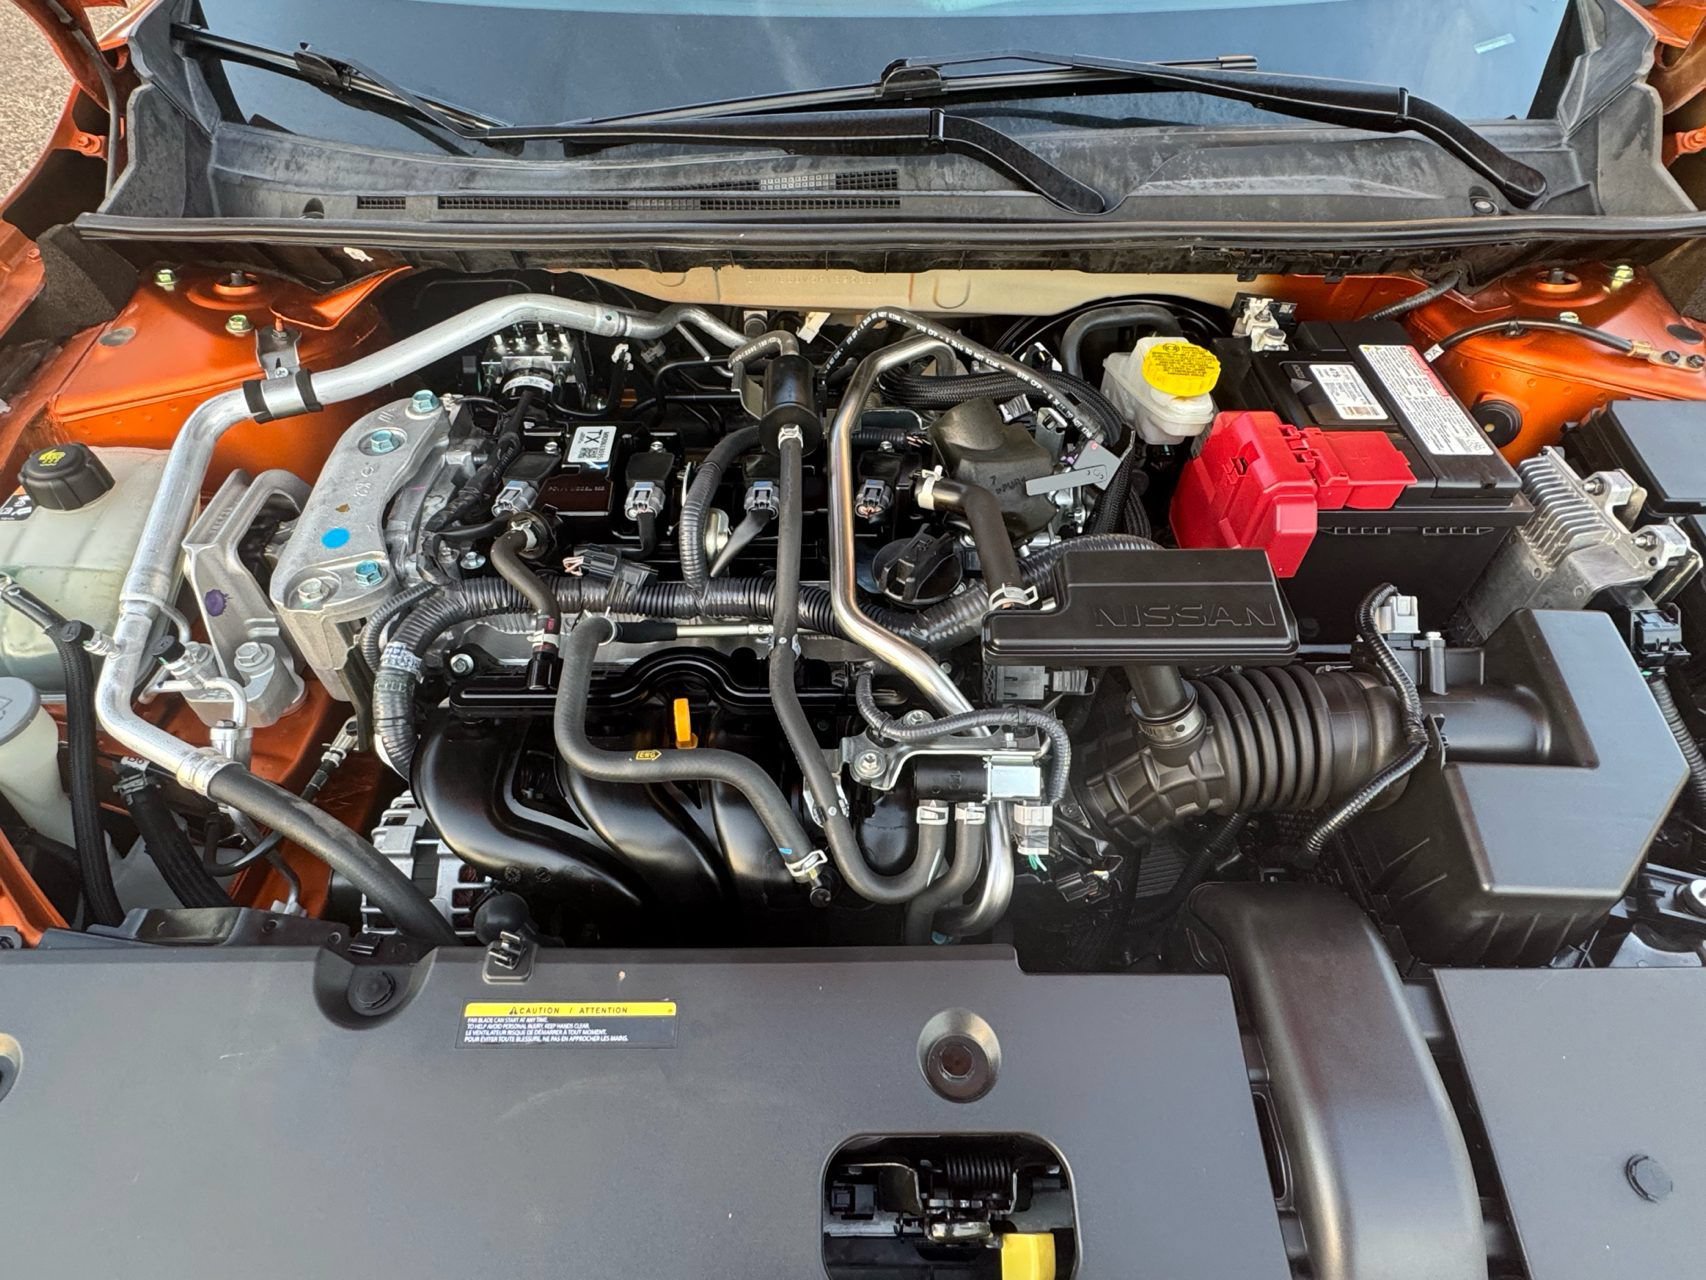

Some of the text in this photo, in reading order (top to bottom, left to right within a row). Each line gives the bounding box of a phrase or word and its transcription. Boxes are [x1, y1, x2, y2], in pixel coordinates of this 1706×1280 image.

[1096, 604, 1277, 627] NISSAN
[519, 1006, 560, 1014] CAUTION
[578, 1006, 628, 1014] ATTENTION
